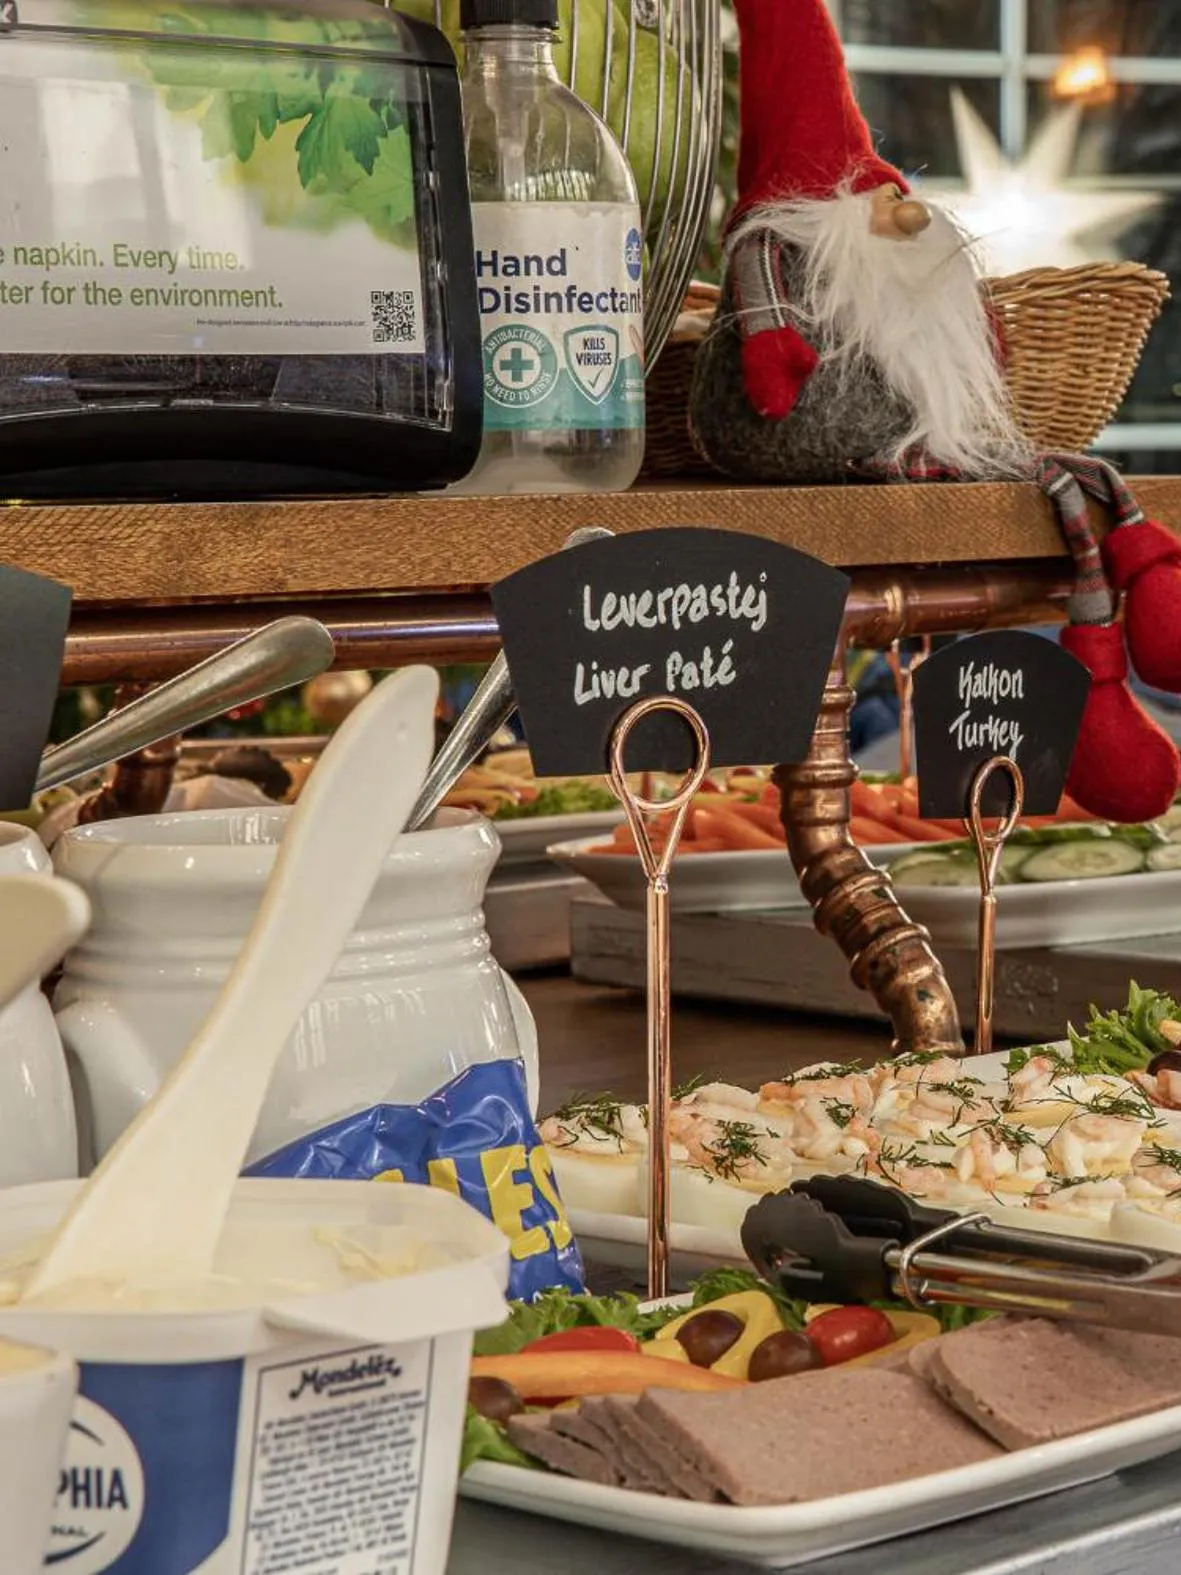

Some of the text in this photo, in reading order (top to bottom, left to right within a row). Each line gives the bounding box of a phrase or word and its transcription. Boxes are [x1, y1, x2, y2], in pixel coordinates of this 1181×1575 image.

[14, 241, 104, 271] napkin.
[113, 244, 178, 274] Every
[188, 246, 246, 270] time.
[476, 248, 567, 277] Hand
[41, 281, 75, 305] for
[83, 282, 122, 306] the
[131, 283, 283, 308] environment.
[478, 285, 642, 314] Disinfectant
[484, 328, 546, 354] ANTIBACTERIAL
[583, 337, 605, 350] KILLS
[576, 352, 612, 366] VIRUSES
[583, 571, 767, 632] Leverpastej
[574, 639, 736, 705] Liver Paté
[959, 661, 1024, 708] Kalkon
[949, 710, 1024, 761] Turkey
